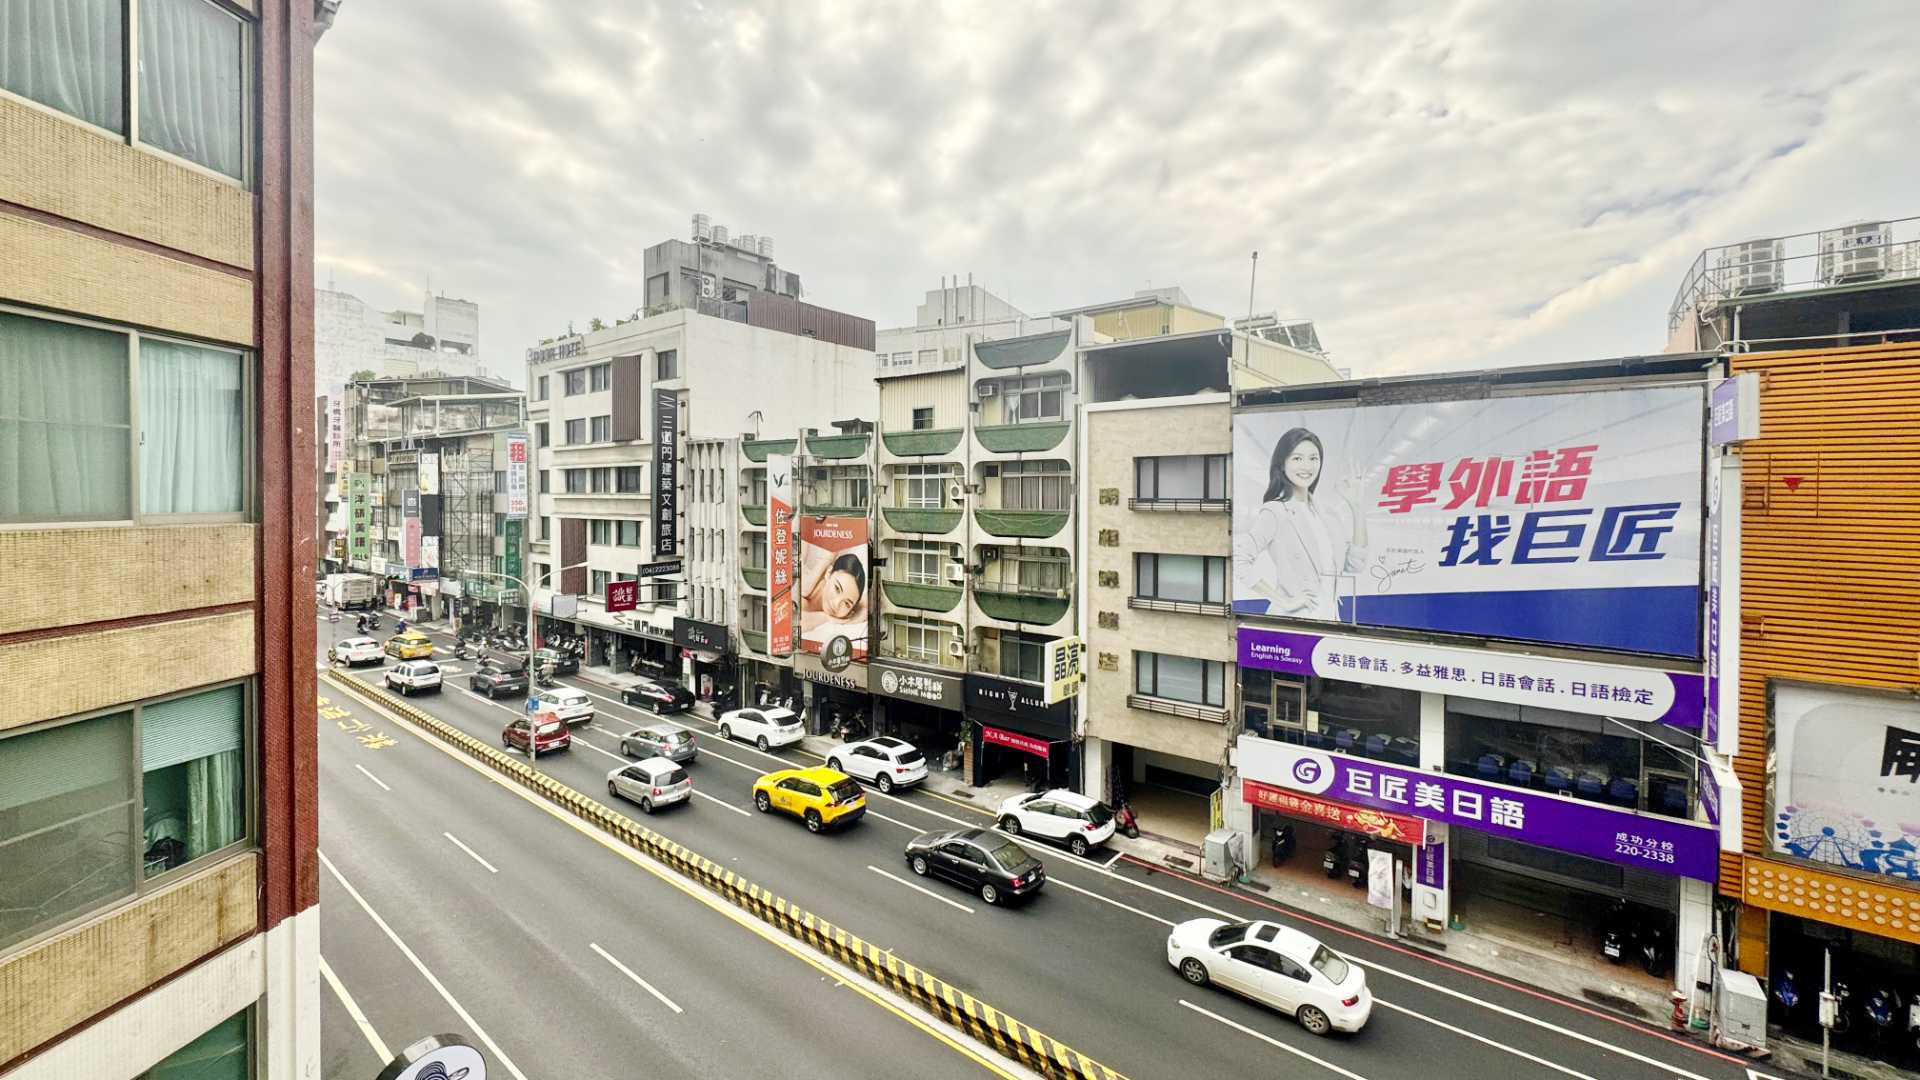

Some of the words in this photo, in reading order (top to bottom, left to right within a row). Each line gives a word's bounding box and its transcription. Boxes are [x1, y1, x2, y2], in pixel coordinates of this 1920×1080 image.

[1378, 444, 1599, 514] 學外語
[1438, 502, 1681, 567] 找巨匠
[775, 508, 789, 585] 佐登妮絲
[1251, 642, 1291, 657] Learning
[1251, 651, 1274, 661] English
[802, 669, 856, 689] JOURDENESS
[1345, 767, 1525, 829] 巨匠美日語
[1615, 831, 1674, 852] 成功分校
[1615, 843, 1675, 864] 220-2338
